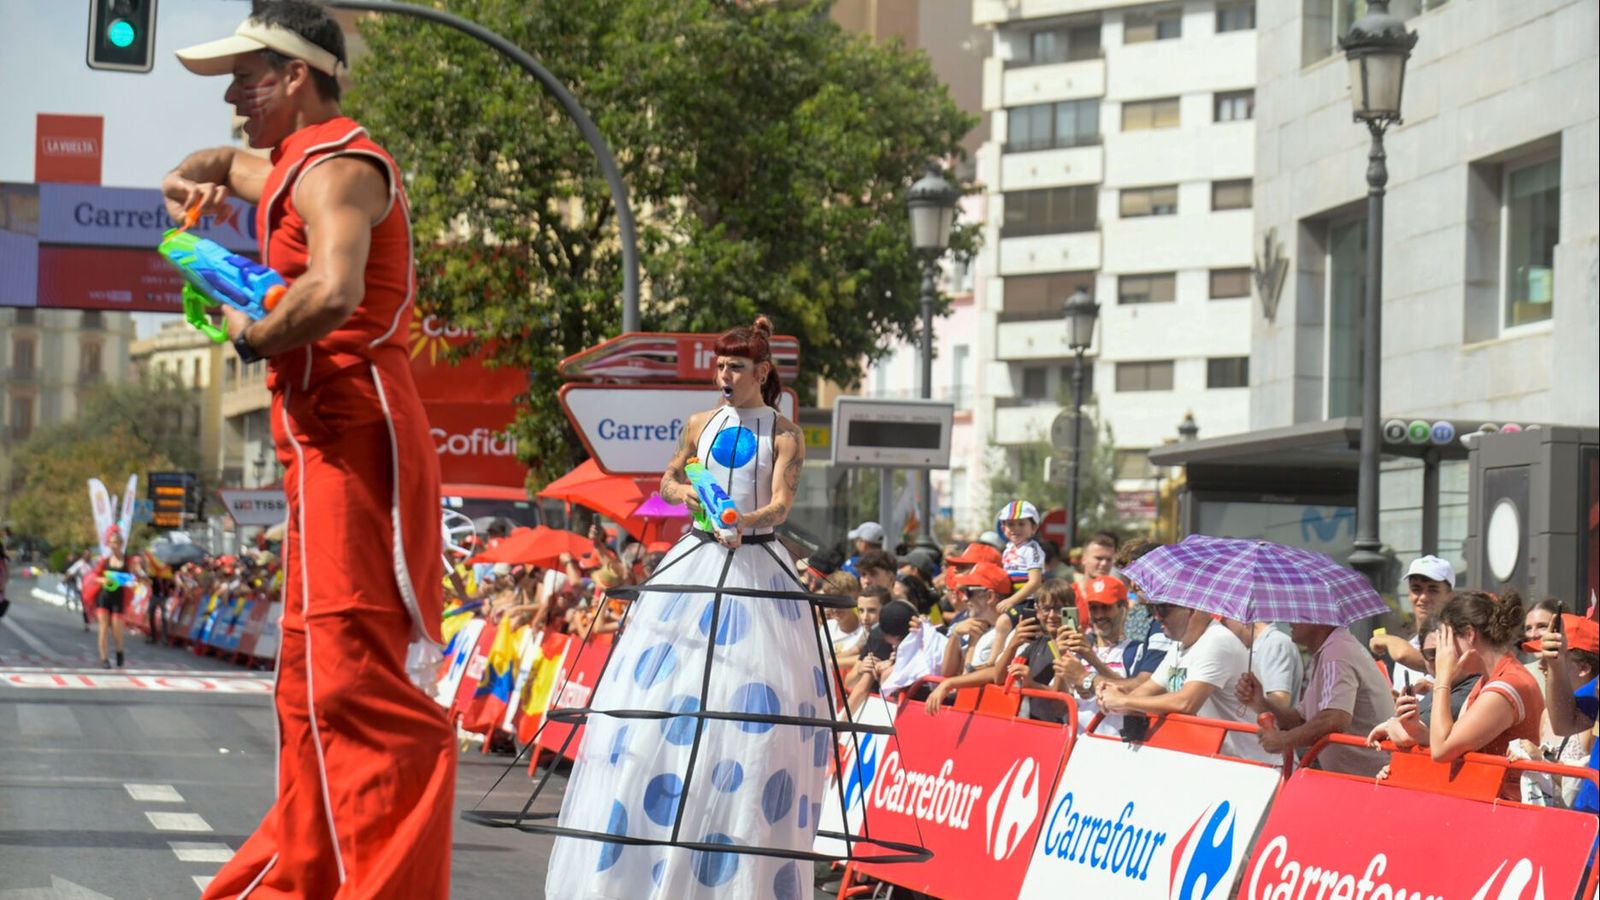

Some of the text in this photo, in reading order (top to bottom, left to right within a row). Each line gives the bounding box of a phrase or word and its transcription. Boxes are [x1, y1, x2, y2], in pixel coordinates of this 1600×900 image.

[74, 201, 214, 231] Carrefr
[430, 428, 517, 456] Cofidi
[597, 418, 684, 441] Carref
[874, 750, 983, 830] Carrefour
[1045, 792, 1167, 881] Carrefour
